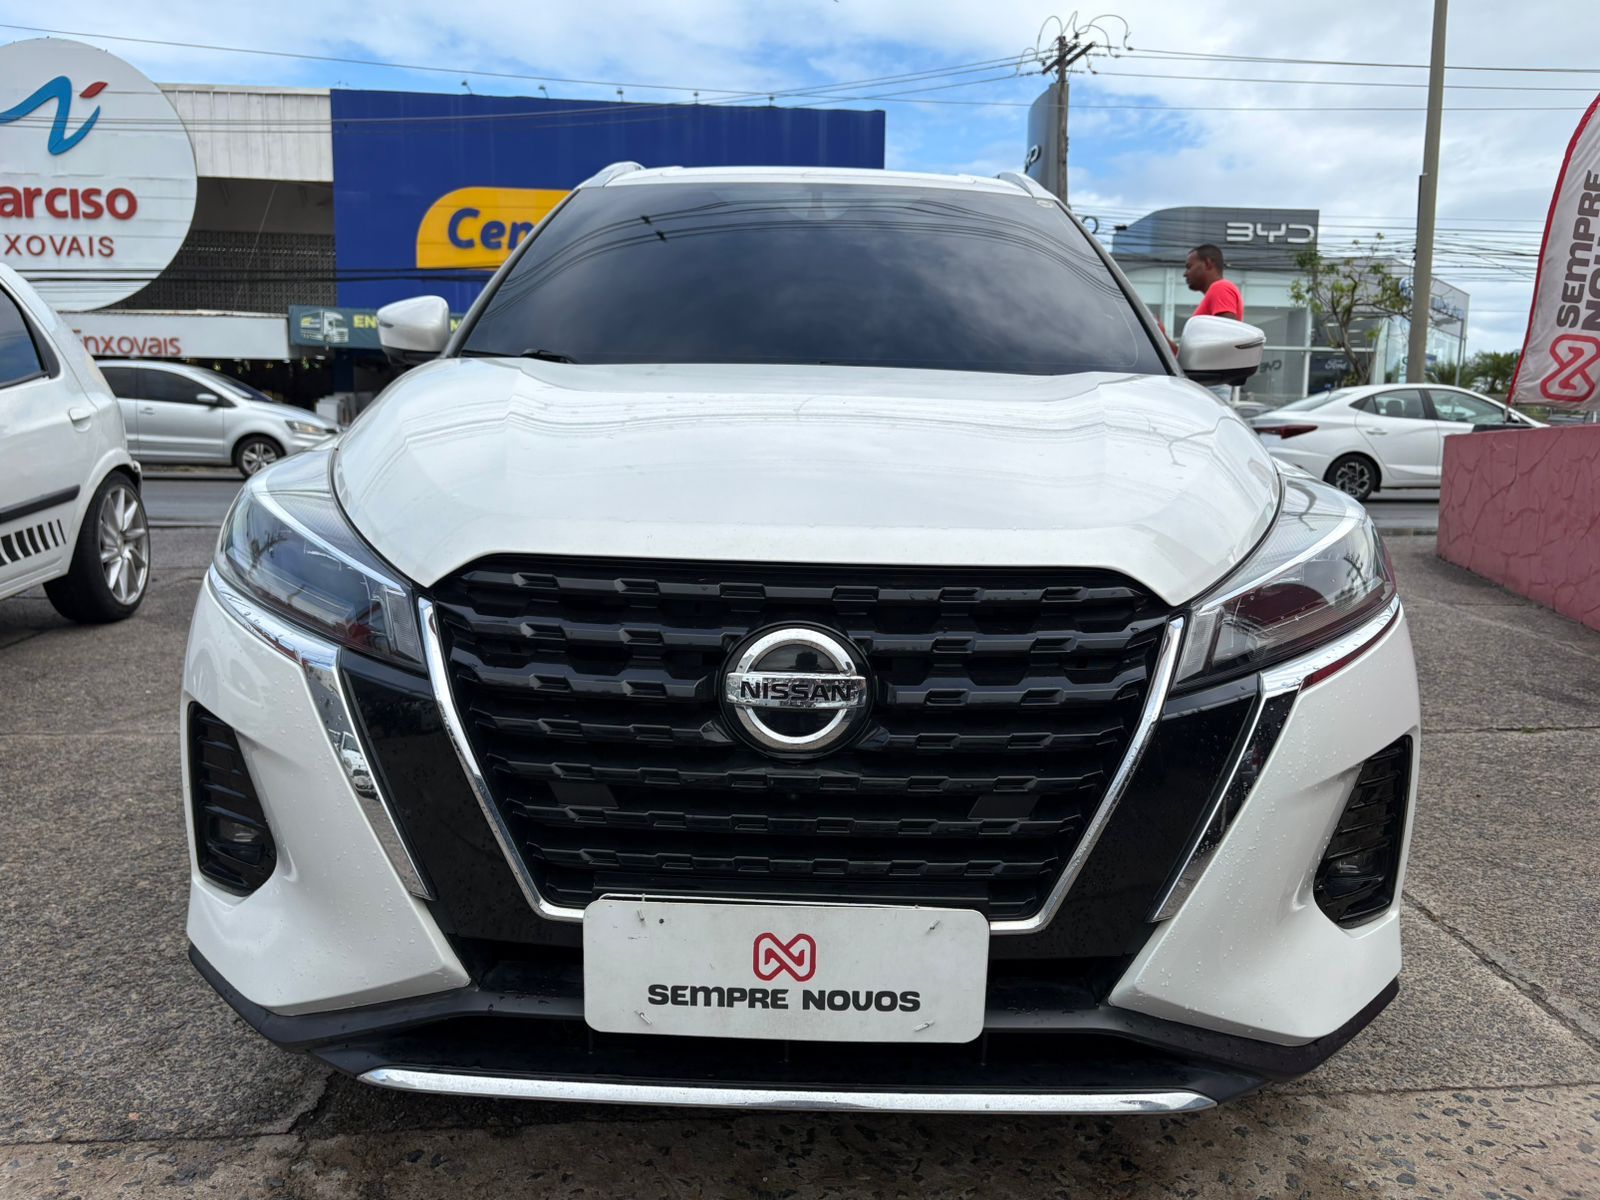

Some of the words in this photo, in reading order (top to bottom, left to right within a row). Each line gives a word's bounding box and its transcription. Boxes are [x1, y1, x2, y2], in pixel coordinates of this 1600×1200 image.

[1226, 222, 1315, 243] BYD
[4, 234, 115, 258] XOVAIS
[72, 328, 182, 355] nxovais
[740, 680, 852, 702] NISSAN
[647, 983, 789, 1010] SEMPRE
